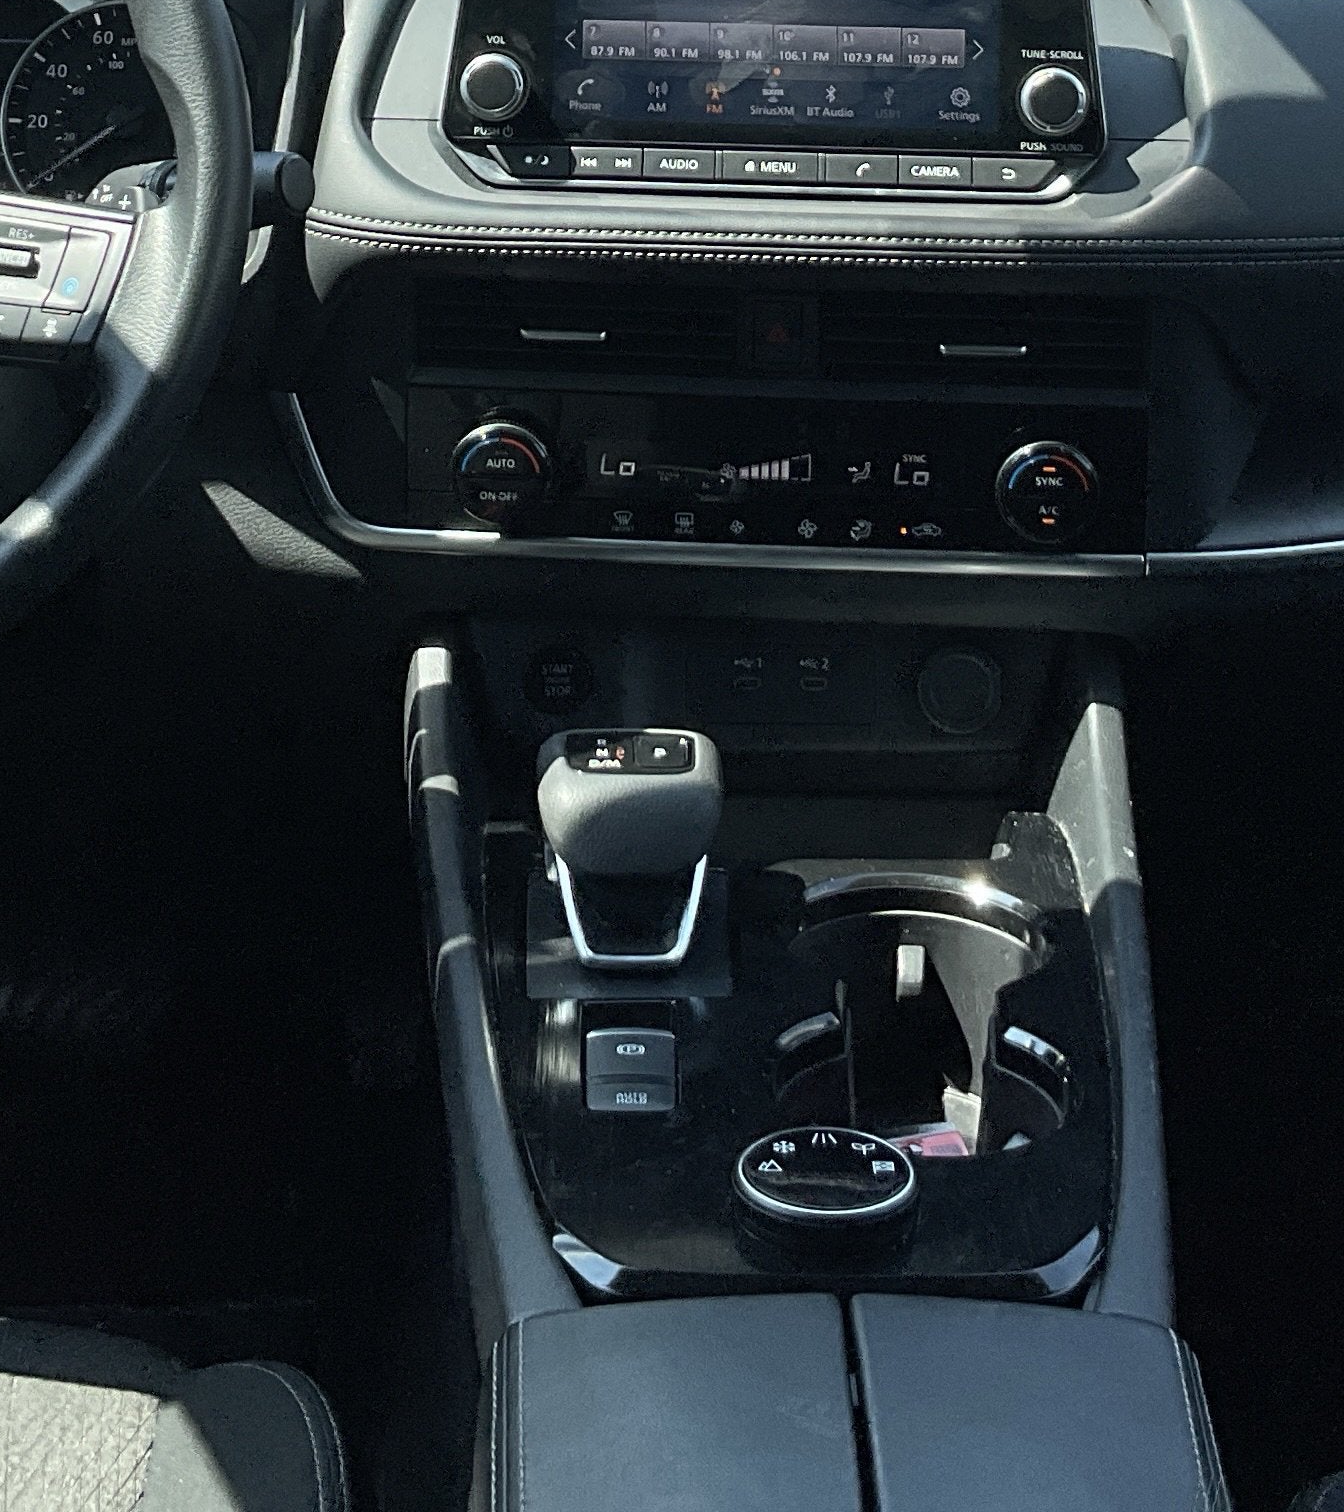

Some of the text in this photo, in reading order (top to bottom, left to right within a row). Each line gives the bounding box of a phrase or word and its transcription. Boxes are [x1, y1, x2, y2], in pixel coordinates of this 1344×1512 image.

[92, 31, 114, 45] 60
[486, 35, 506, 44] VOL
[842, 32, 854, 43] 11
[907, 34, 920, 45] 12
[590, 45, 635, 57] 87.9 FM
[653, 48, 699, 58] 90.1 FM
[717, 49, 762, 60] 98.1 FM
[779, 50, 830, 62] 106.1 FM
[843, 52, 894, 63] 107.9 FM
[907, 54, 958, 65] 107.9 FM
[108, 60, 124, 70] 100
[46, 64, 67, 78] 40
[569, 100, 602, 112] Phone
[647, 103, 667, 113] AM
[706, 104, 723, 114] FM
[750, 105, 794, 117] SiriusXM
[806, 106, 854, 118] BT Audio
[938, 110, 980, 123] Settings
[27, 114, 48, 129] 20
[1020, 142, 1047, 152] PUSH
[659, 158, 699, 170] AUDIO
[760, 161, 797, 173] MENU
[910, 165, 959, 178] CAMERA
[8, 227, 35, 240] RES+
[486, 458, 516, 469] AUTO
[600, 452, 636, 476] Lo
[902, 454, 928, 463] SYNC
[893, 462, 930, 485] Lo
[1035, 477, 1064, 487] SYNC
[1038, 505, 1060, 515] A/C
